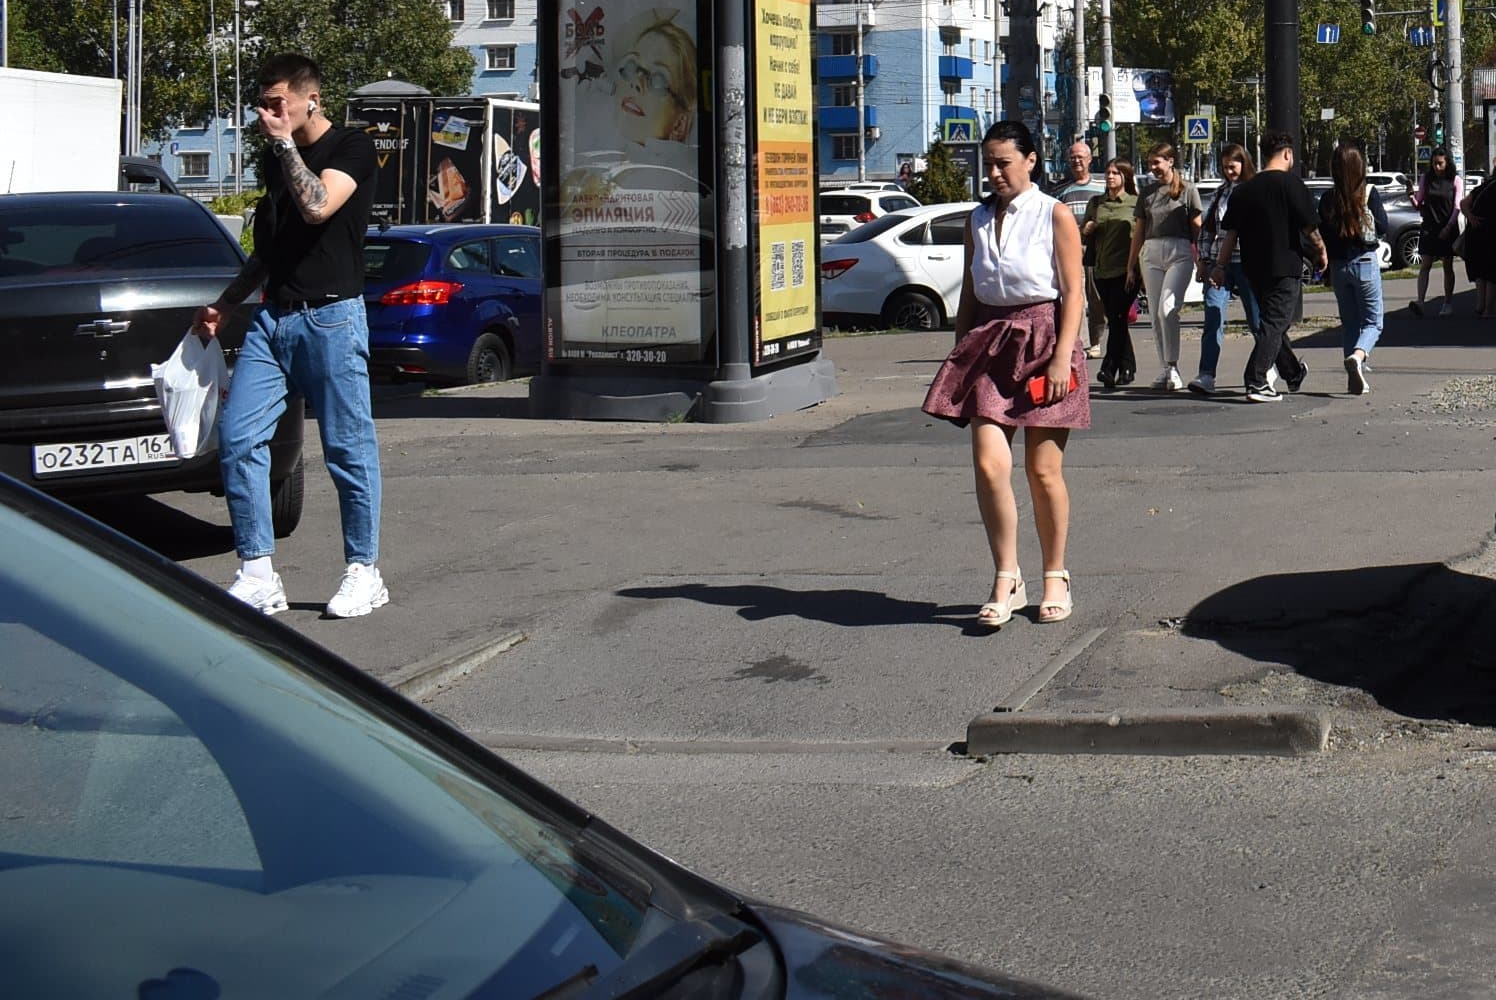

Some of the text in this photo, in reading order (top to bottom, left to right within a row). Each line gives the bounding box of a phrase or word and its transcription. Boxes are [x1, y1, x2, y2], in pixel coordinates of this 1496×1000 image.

[373, 138, 409, 150] ENDORF
[572, 206, 656, 224] ЭПИЛЯЦИЯ
[577, 249, 605, 258] ВТОРАЯ
[607, 249, 650, 258] ПРОЦЕДУРА
[659, 249, 695, 257] ПОДАРОК
[602, 325, 677, 338] КЛЕОПАТРА
[626, 350, 667, 362] 320-30-20
[42, 436, 174, 469] О232ТА 161
